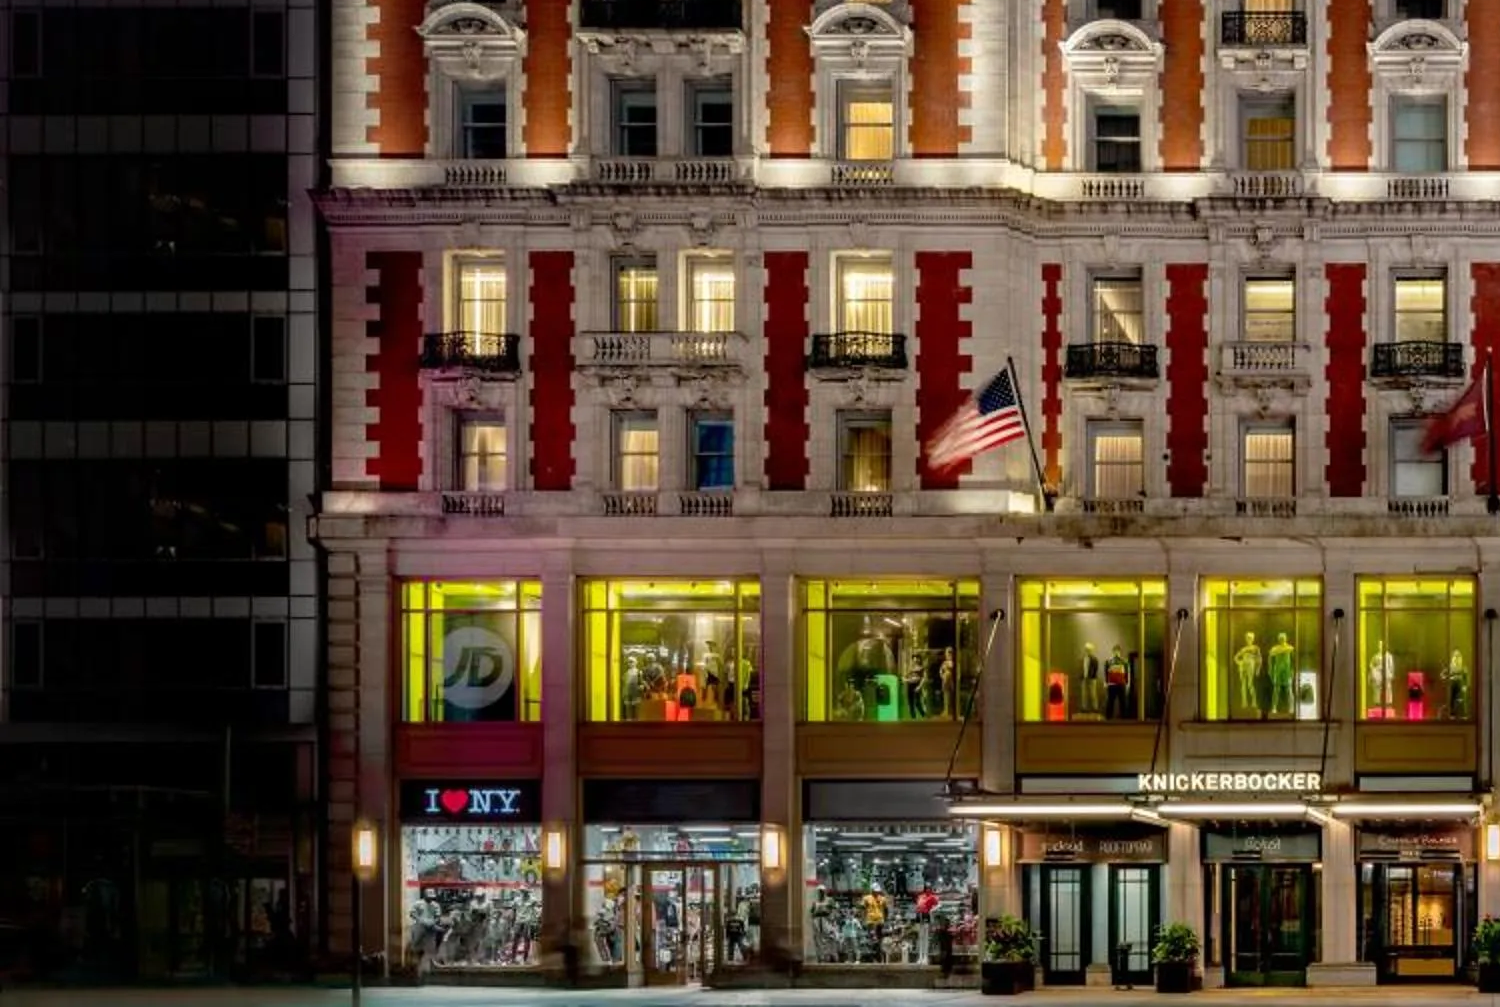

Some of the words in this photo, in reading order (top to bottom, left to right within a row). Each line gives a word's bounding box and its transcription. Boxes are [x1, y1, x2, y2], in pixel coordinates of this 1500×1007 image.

[444, 646, 503, 688] JD
[1137, 772, 1322, 791] KNICKERBOCKER
[424, 788, 440, 813] I
